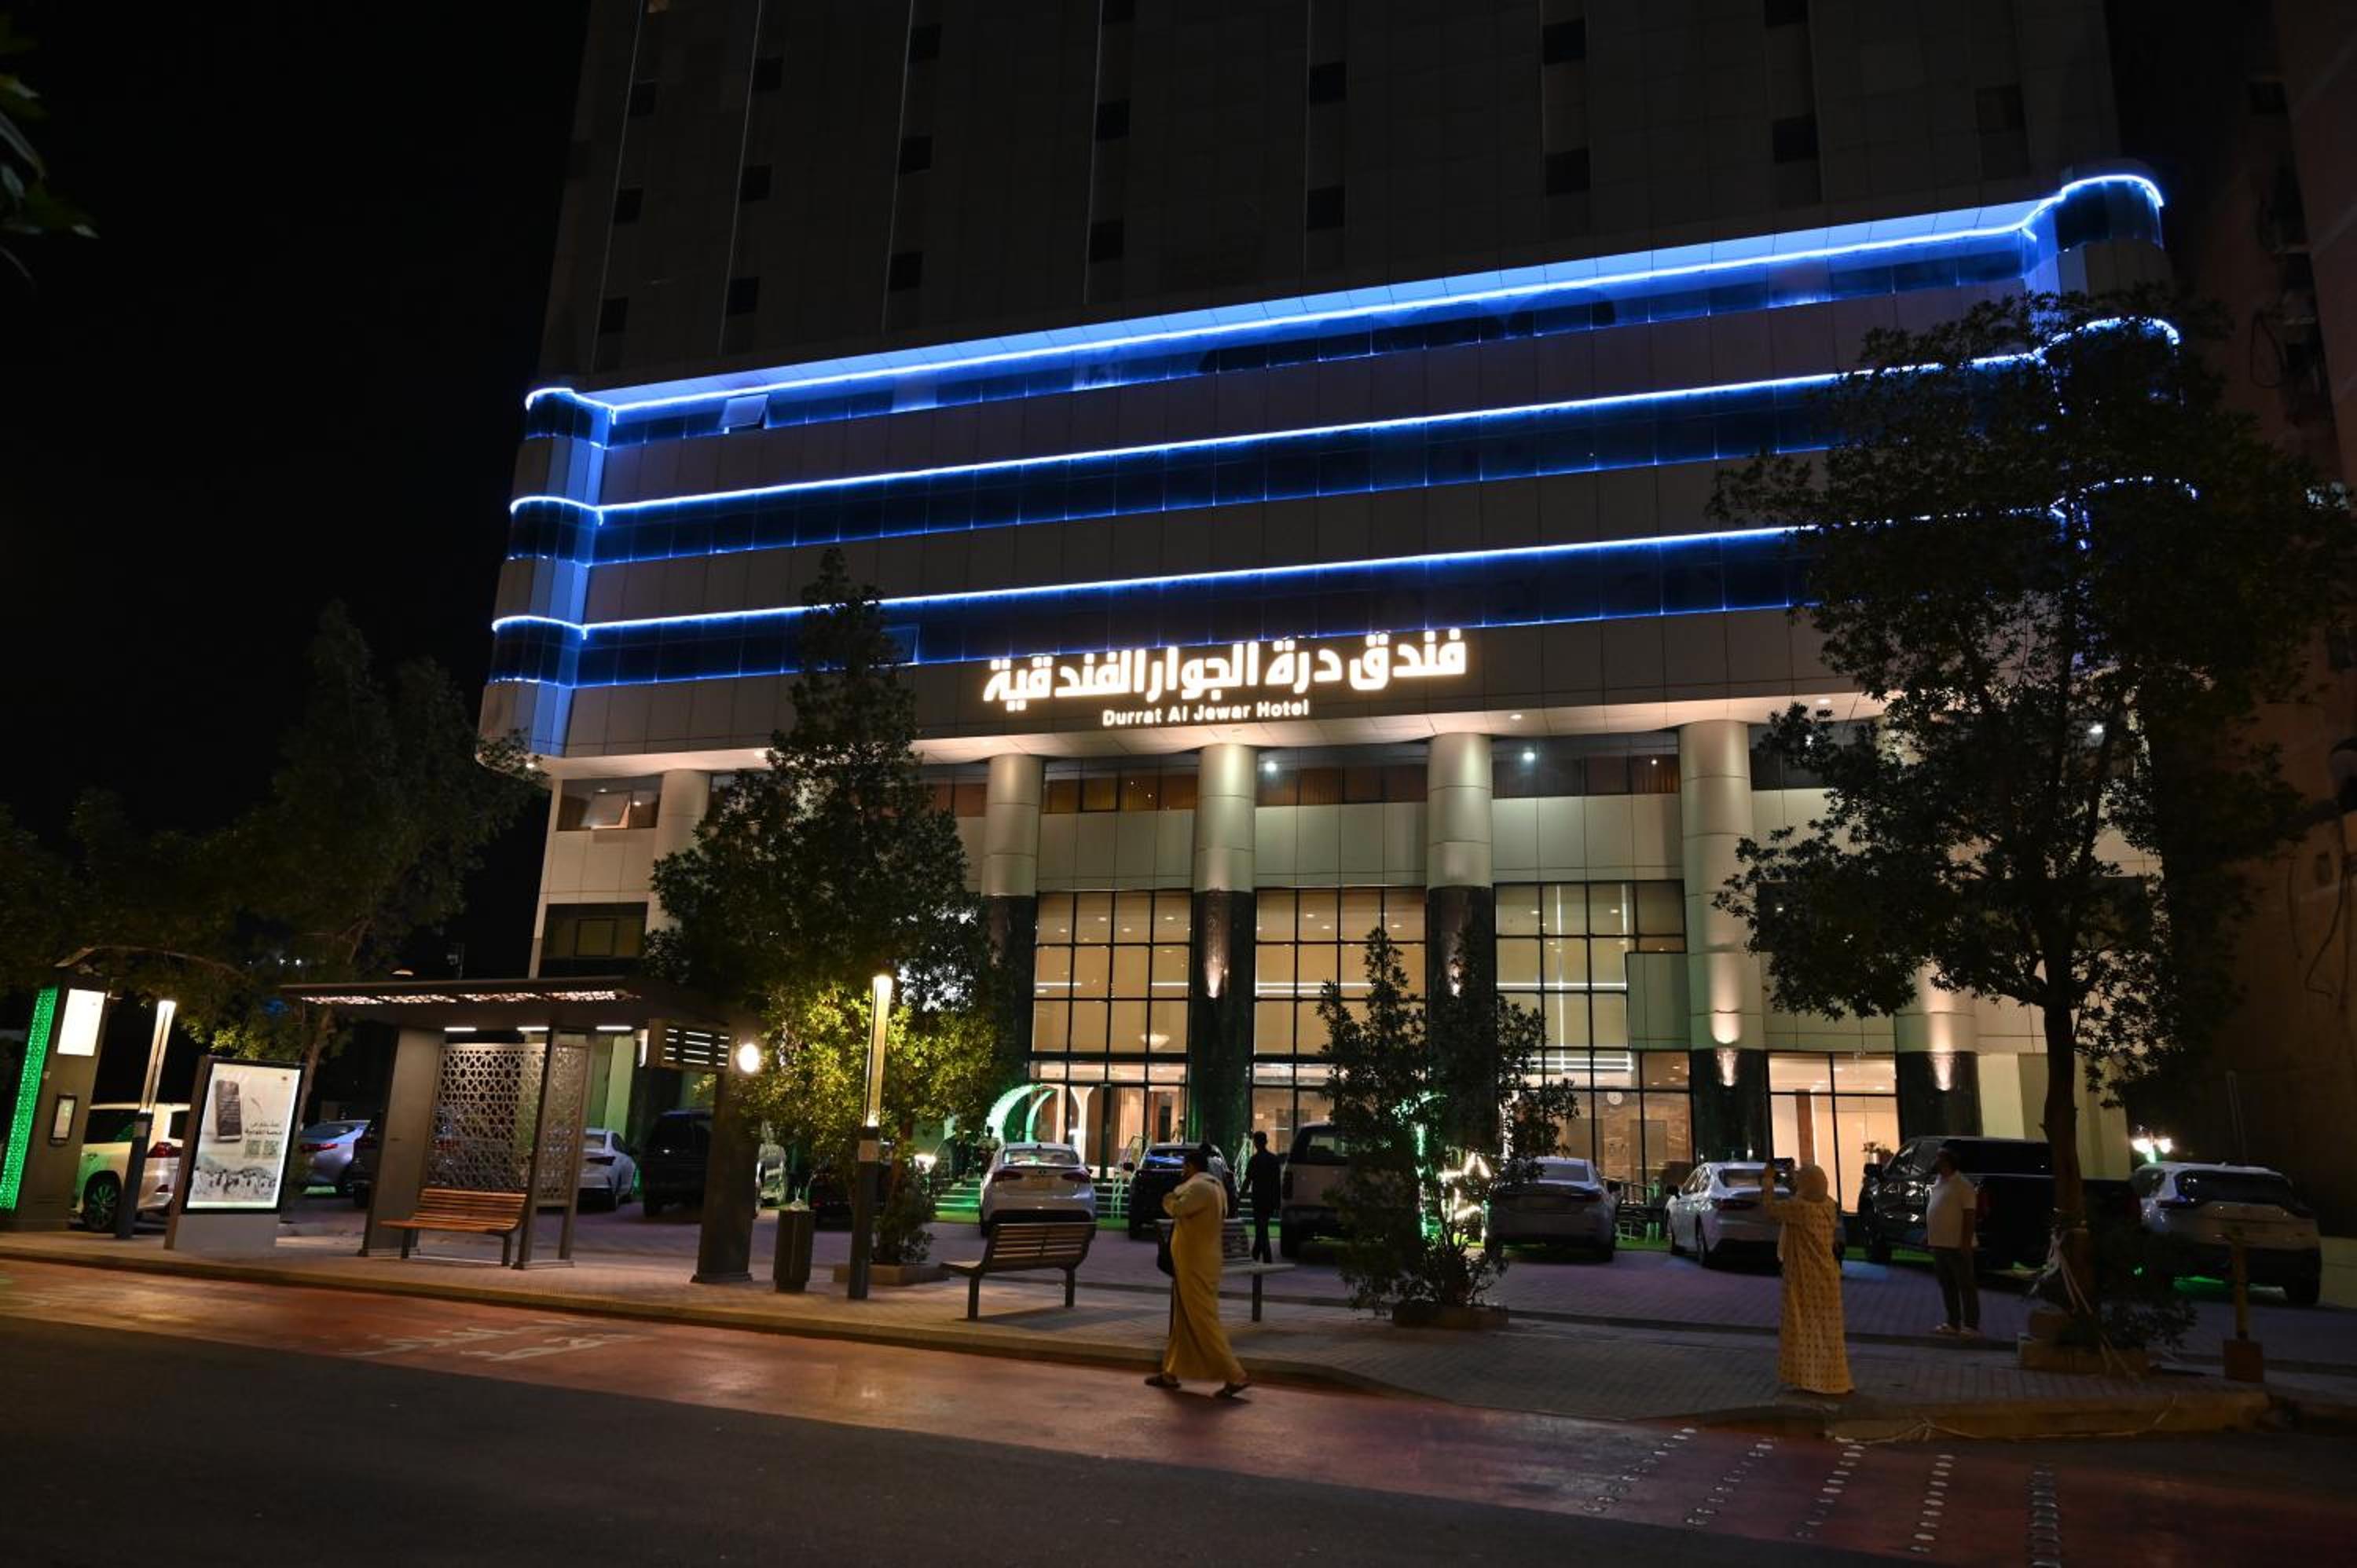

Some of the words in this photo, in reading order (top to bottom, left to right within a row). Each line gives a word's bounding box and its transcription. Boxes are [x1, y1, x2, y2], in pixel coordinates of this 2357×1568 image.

[982, 649, 1147, 712] الفندقية
[1146, 641, 1258, 702] الجوار
[1265, 639, 1343, 694] درة
[1348, 628, 1467, 691] فندق
[1102, 709, 1162, 727] Durrat
[1168, 706, 1188, 723] Al
[1193, 704, 1252, 721] Jewar
[1256, 698, 1309, 718] Hotel
